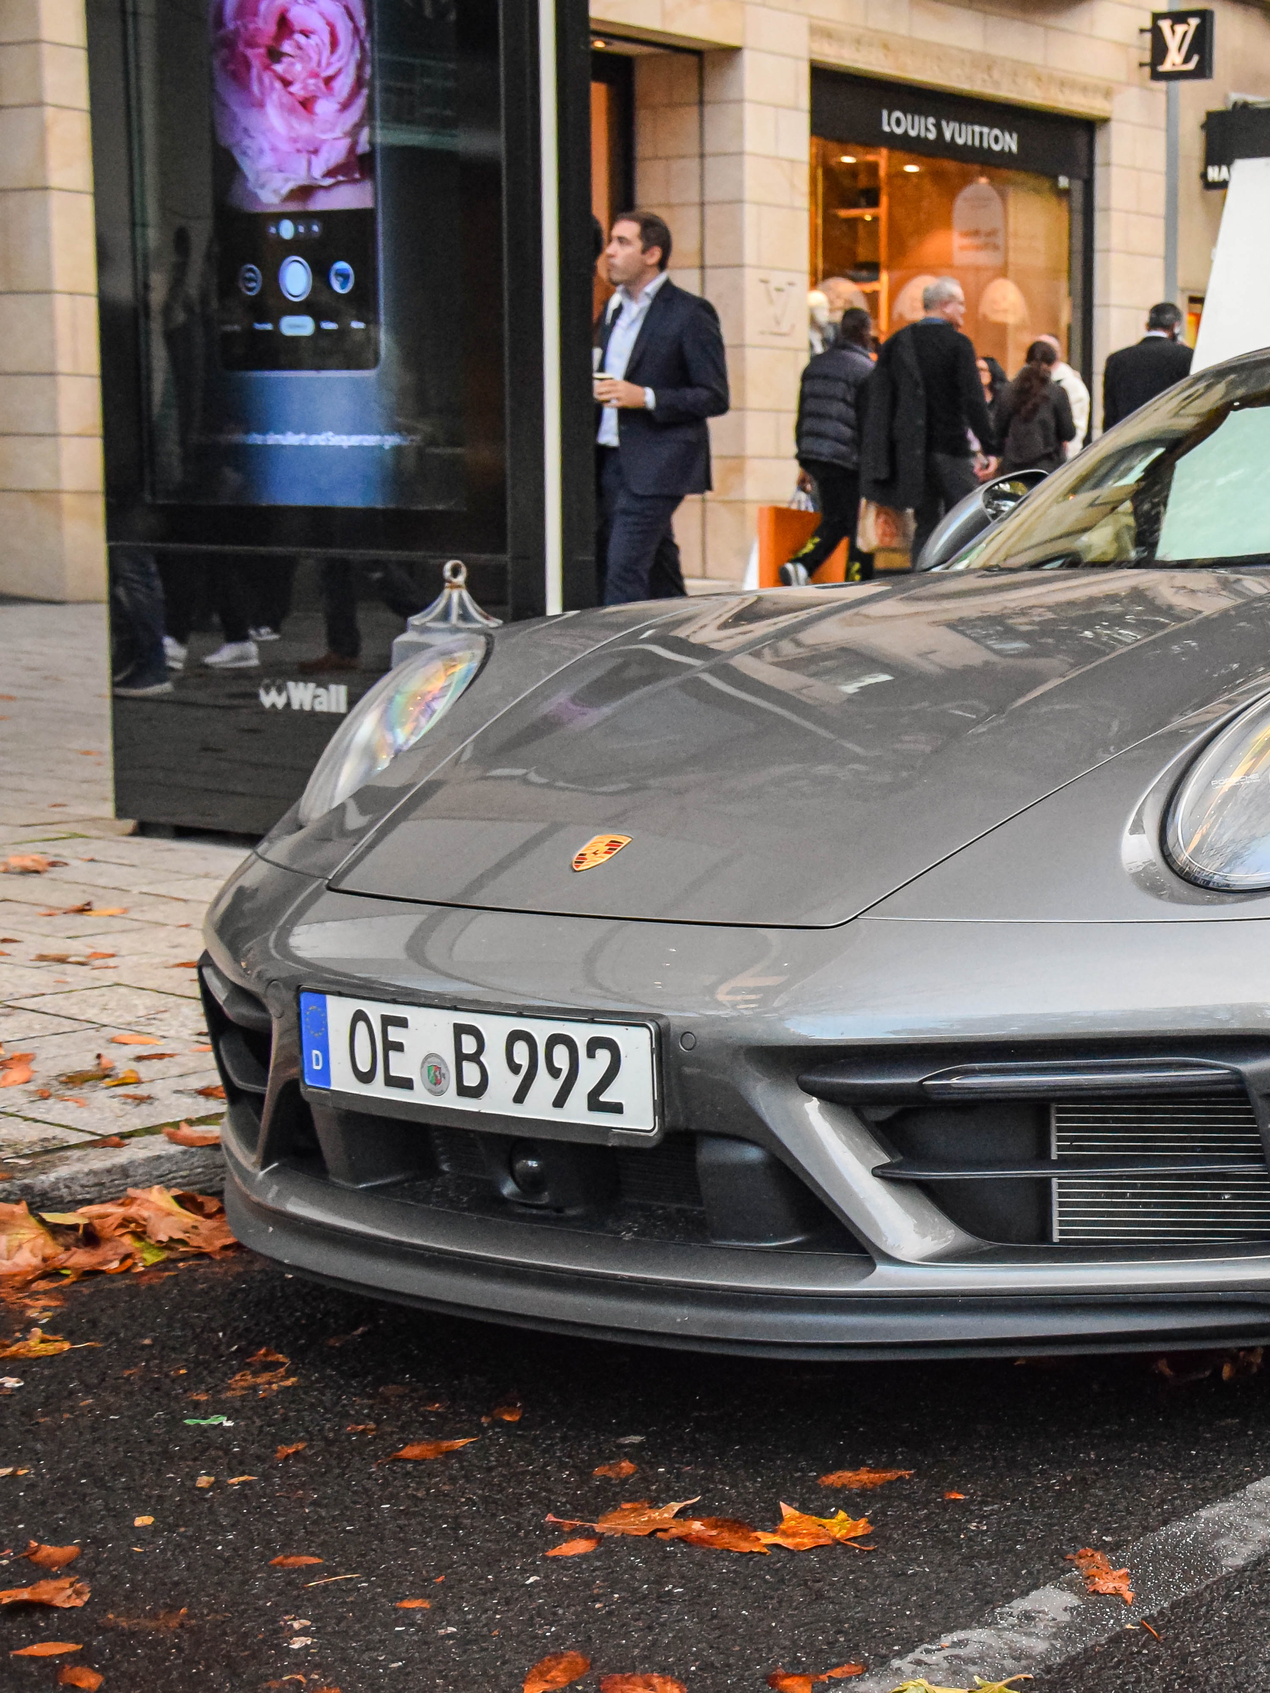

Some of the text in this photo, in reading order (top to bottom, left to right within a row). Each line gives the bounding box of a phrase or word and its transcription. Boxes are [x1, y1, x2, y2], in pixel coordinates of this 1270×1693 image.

[881, 109, 1018, 155] LOUIS VUITTON
[286, 681, 348, 713] Wall
[312, 1049, 323, 1070] D
[349, 1008, 414, 1090] OE
[505, 1028, 625, 1115] 992
